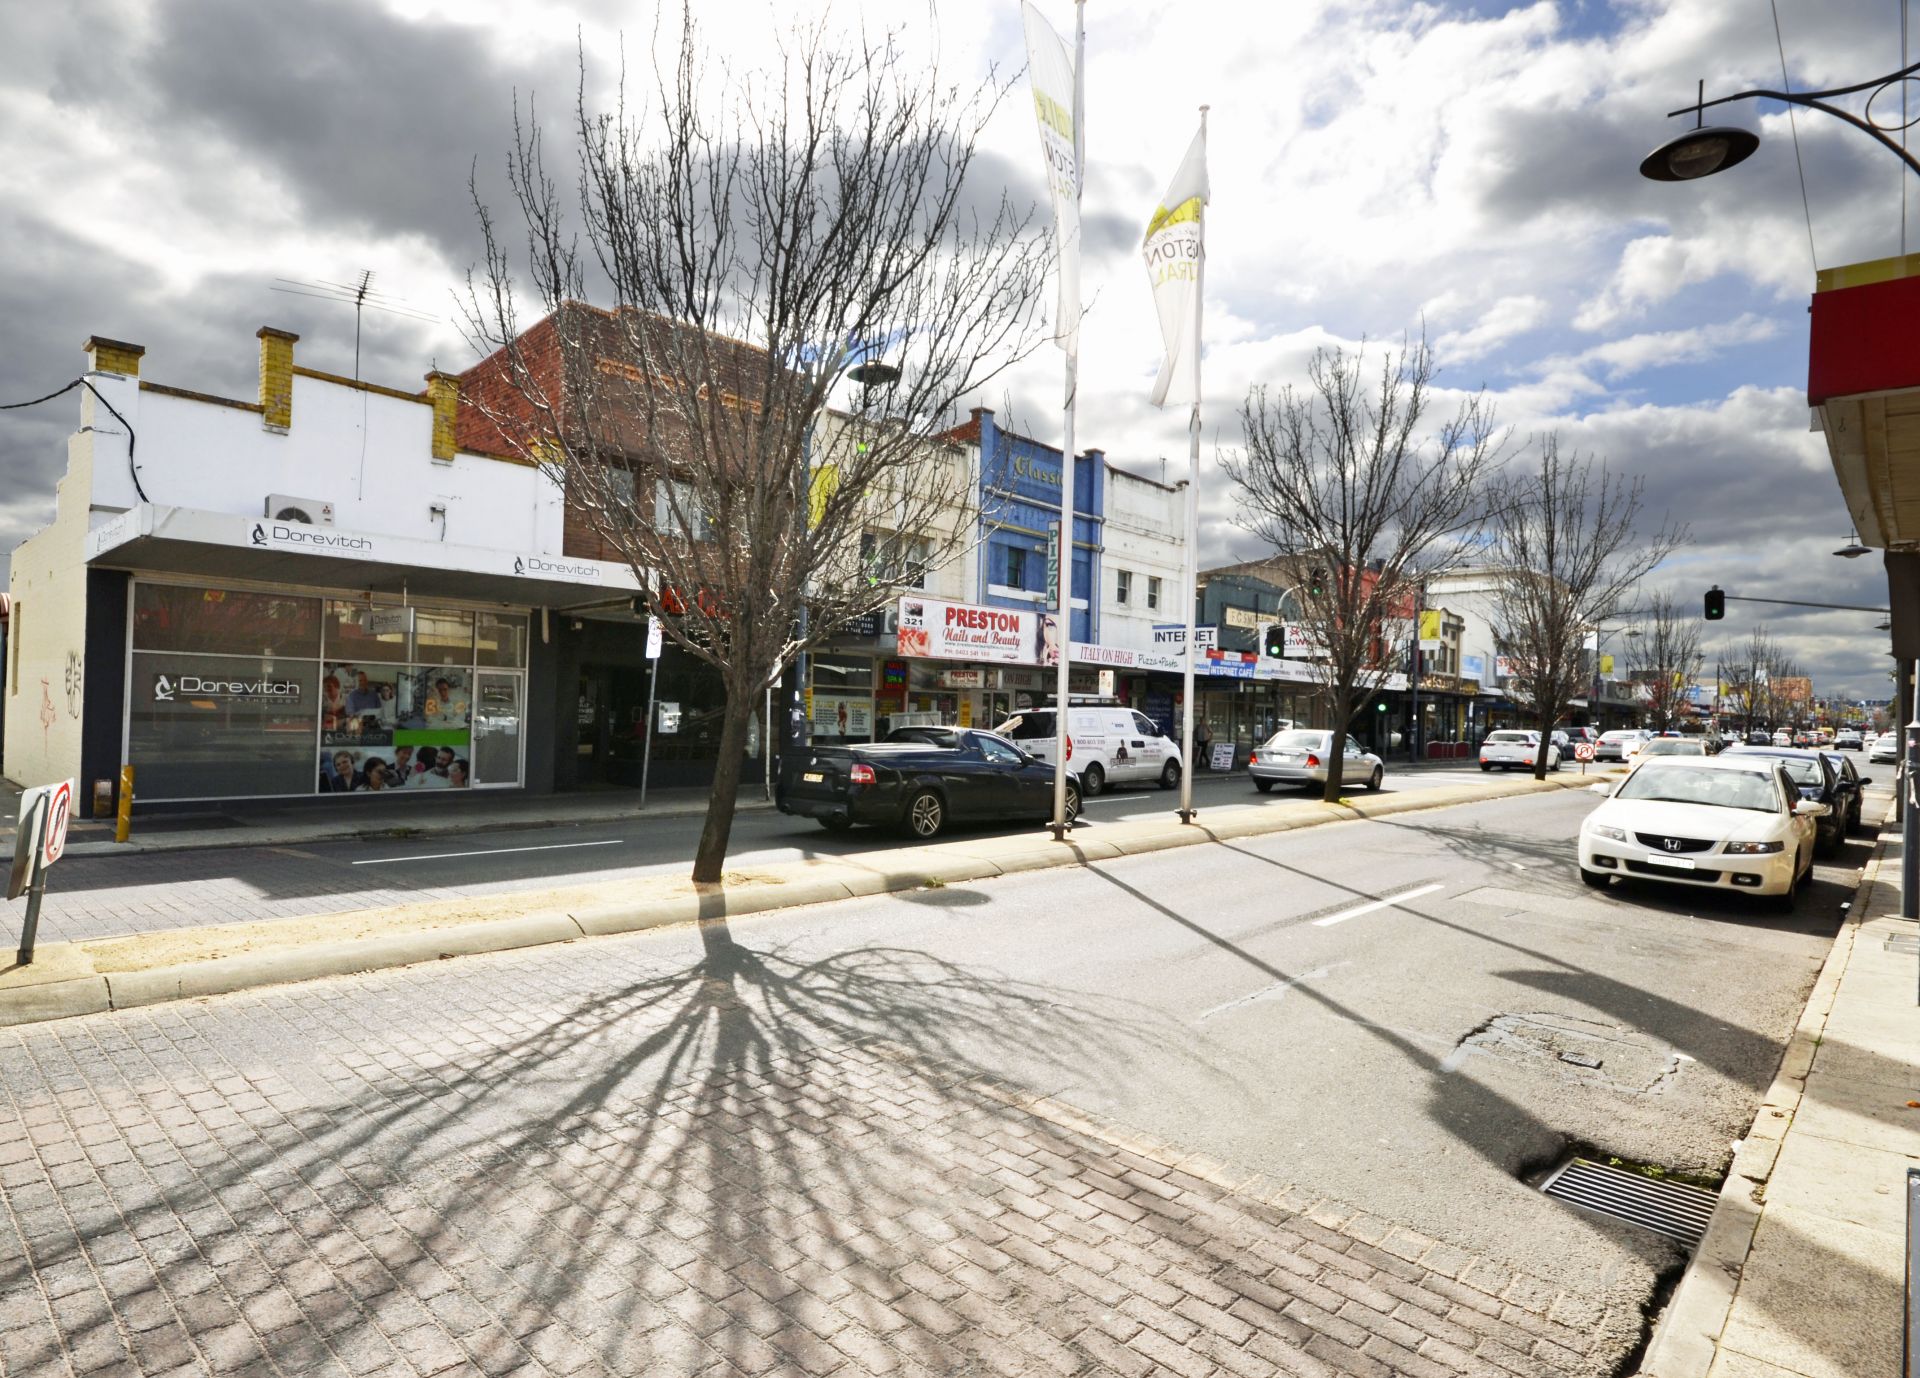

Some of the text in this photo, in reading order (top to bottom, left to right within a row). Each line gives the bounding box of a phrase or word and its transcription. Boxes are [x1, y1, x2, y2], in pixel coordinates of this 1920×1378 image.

[273, 526, 372, 550] Dorevitch
[528, 558, 600, 577] Dorevitch
[1048, 530, 1058, 602] PIZZA
[904, 617, 923, 626] 321
[945, 606, 1020, 633] PRESTON
[942, 627, 1021, 650] Nails and Beauty
[1080, 645, 1179, 668] ITALY ON HIGH Pizza Pasta
[180, 676, 300, 695] Dorevitch
